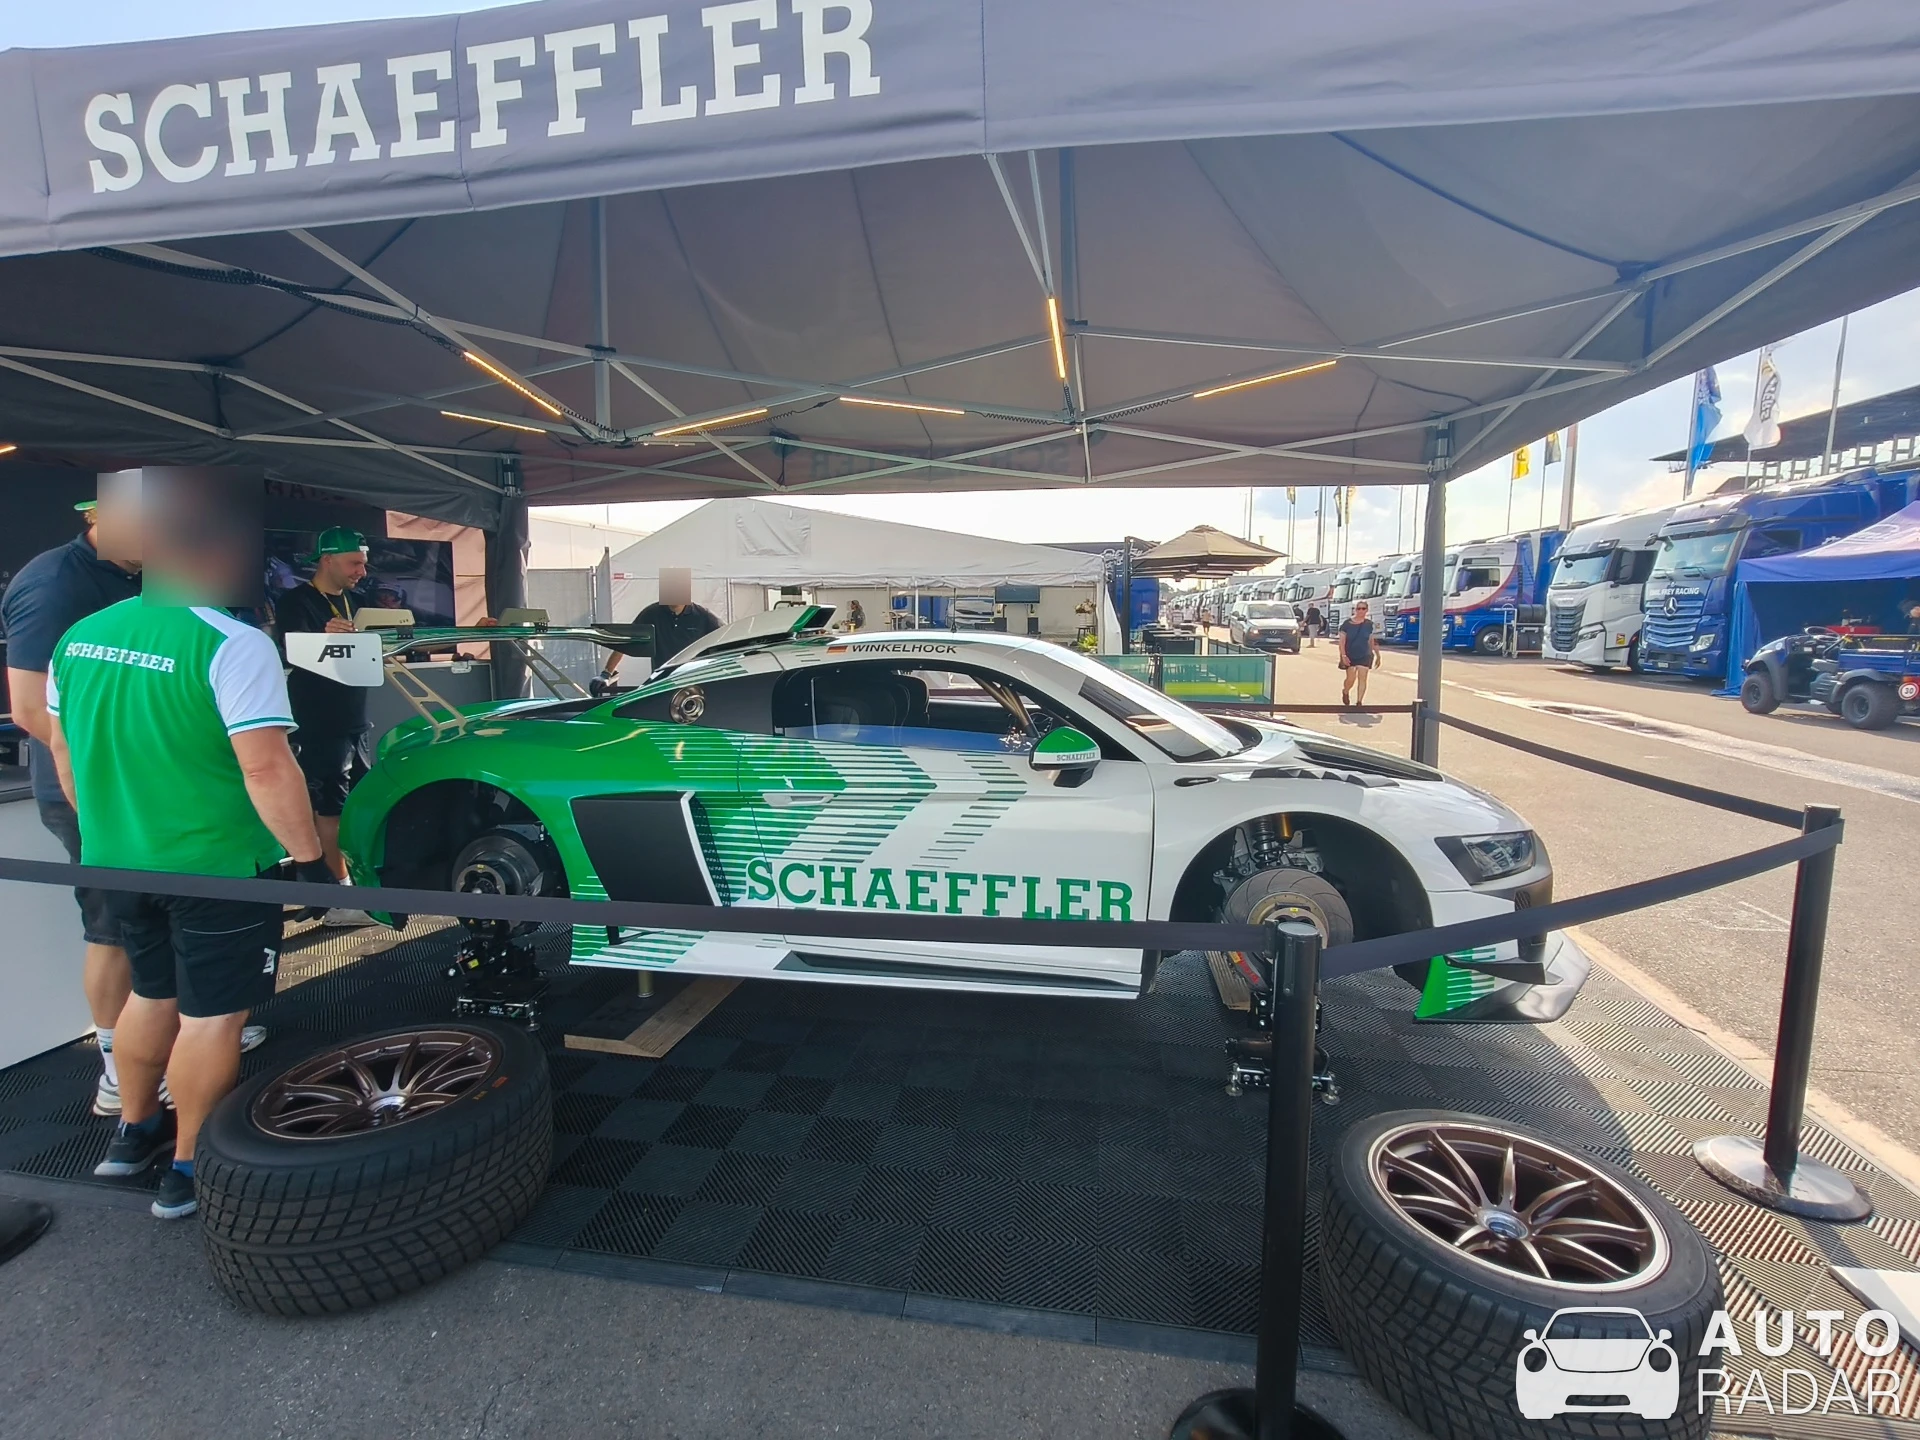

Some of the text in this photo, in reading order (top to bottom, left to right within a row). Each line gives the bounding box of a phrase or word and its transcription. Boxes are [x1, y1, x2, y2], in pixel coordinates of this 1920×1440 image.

[84, 0, 880, 194] SCHAEFFLER
[317, 644, 356, 662] ABT
[852, 643, 957, 654] WINKELHOCK
[1904, 687, 1914, 695] 30
[1056, 752, 1096, 762] SCHAEFFLER
[747, 859, 1135, 922] SCHAEFFLER
